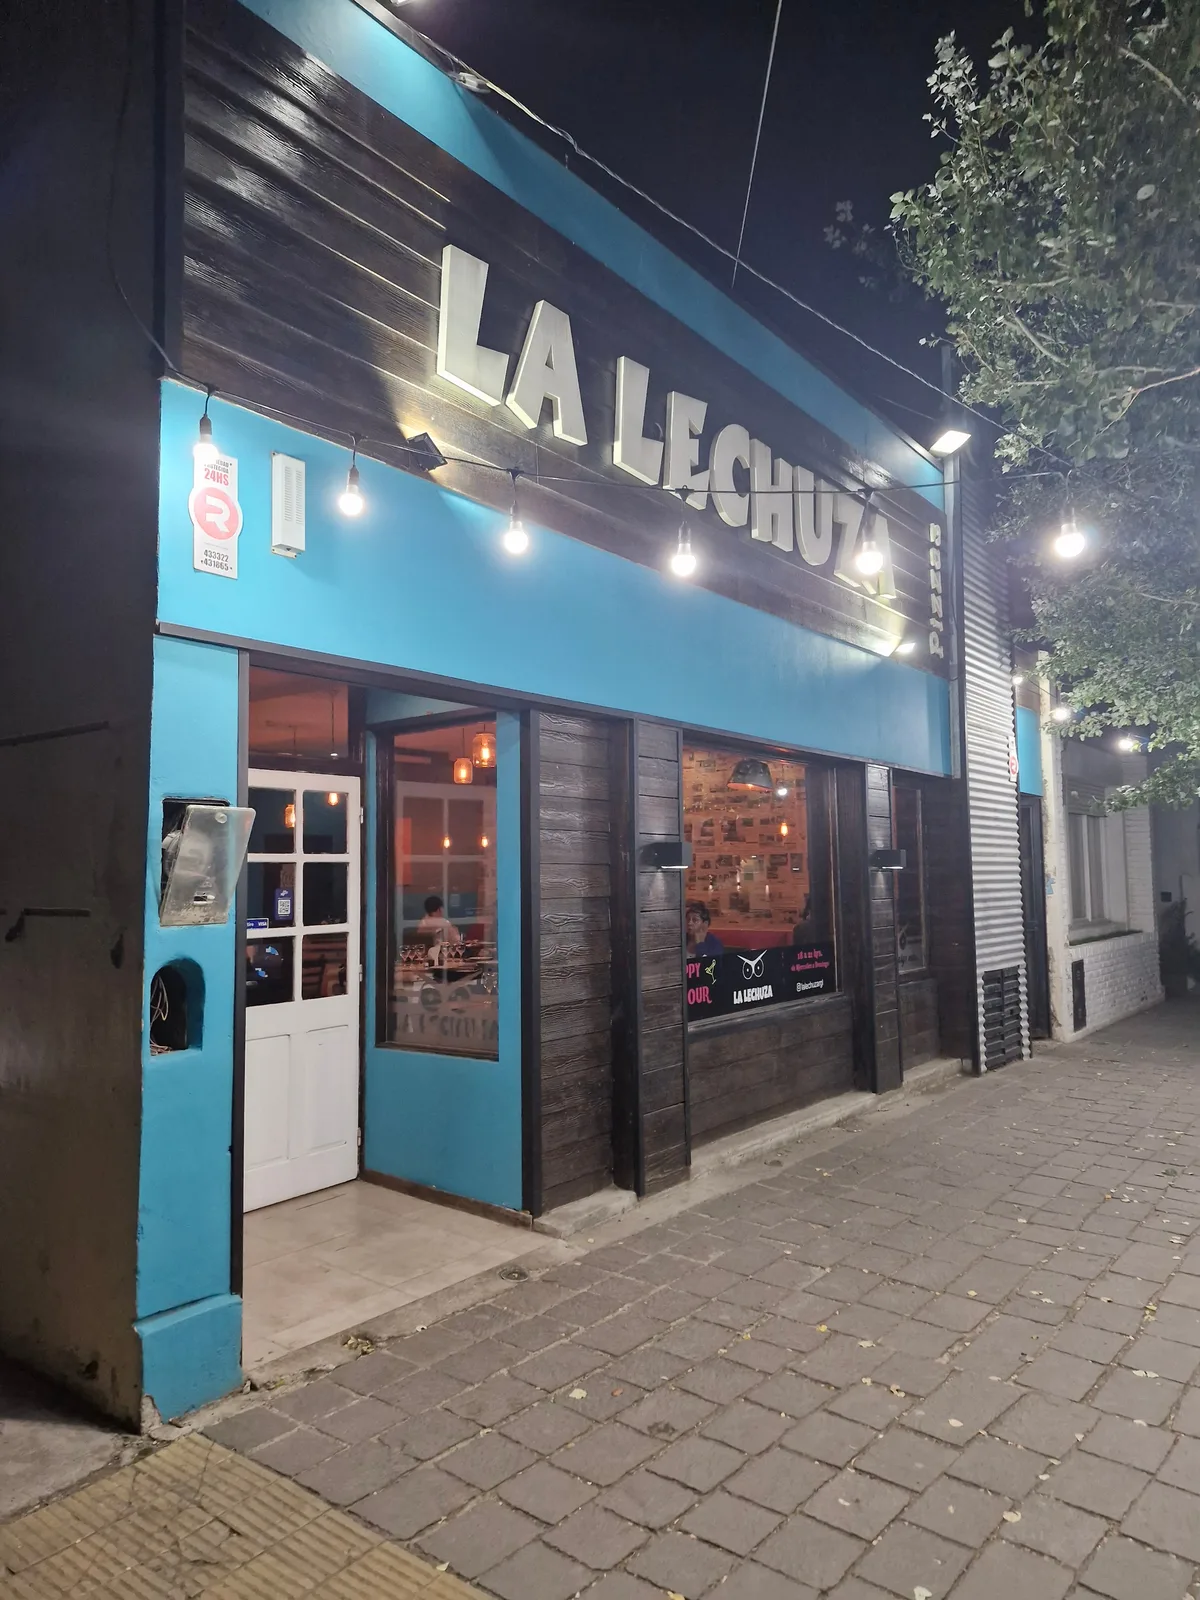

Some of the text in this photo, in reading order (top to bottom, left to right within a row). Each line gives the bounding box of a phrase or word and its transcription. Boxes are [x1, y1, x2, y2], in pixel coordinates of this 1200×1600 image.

[436, 244, 897, 600] LA LECHUZA
[204, 467, 229, 486] 24HS
[203, 549, 229, 562] 433322
[733, 984, 773, 1005] LA LECHUZA
